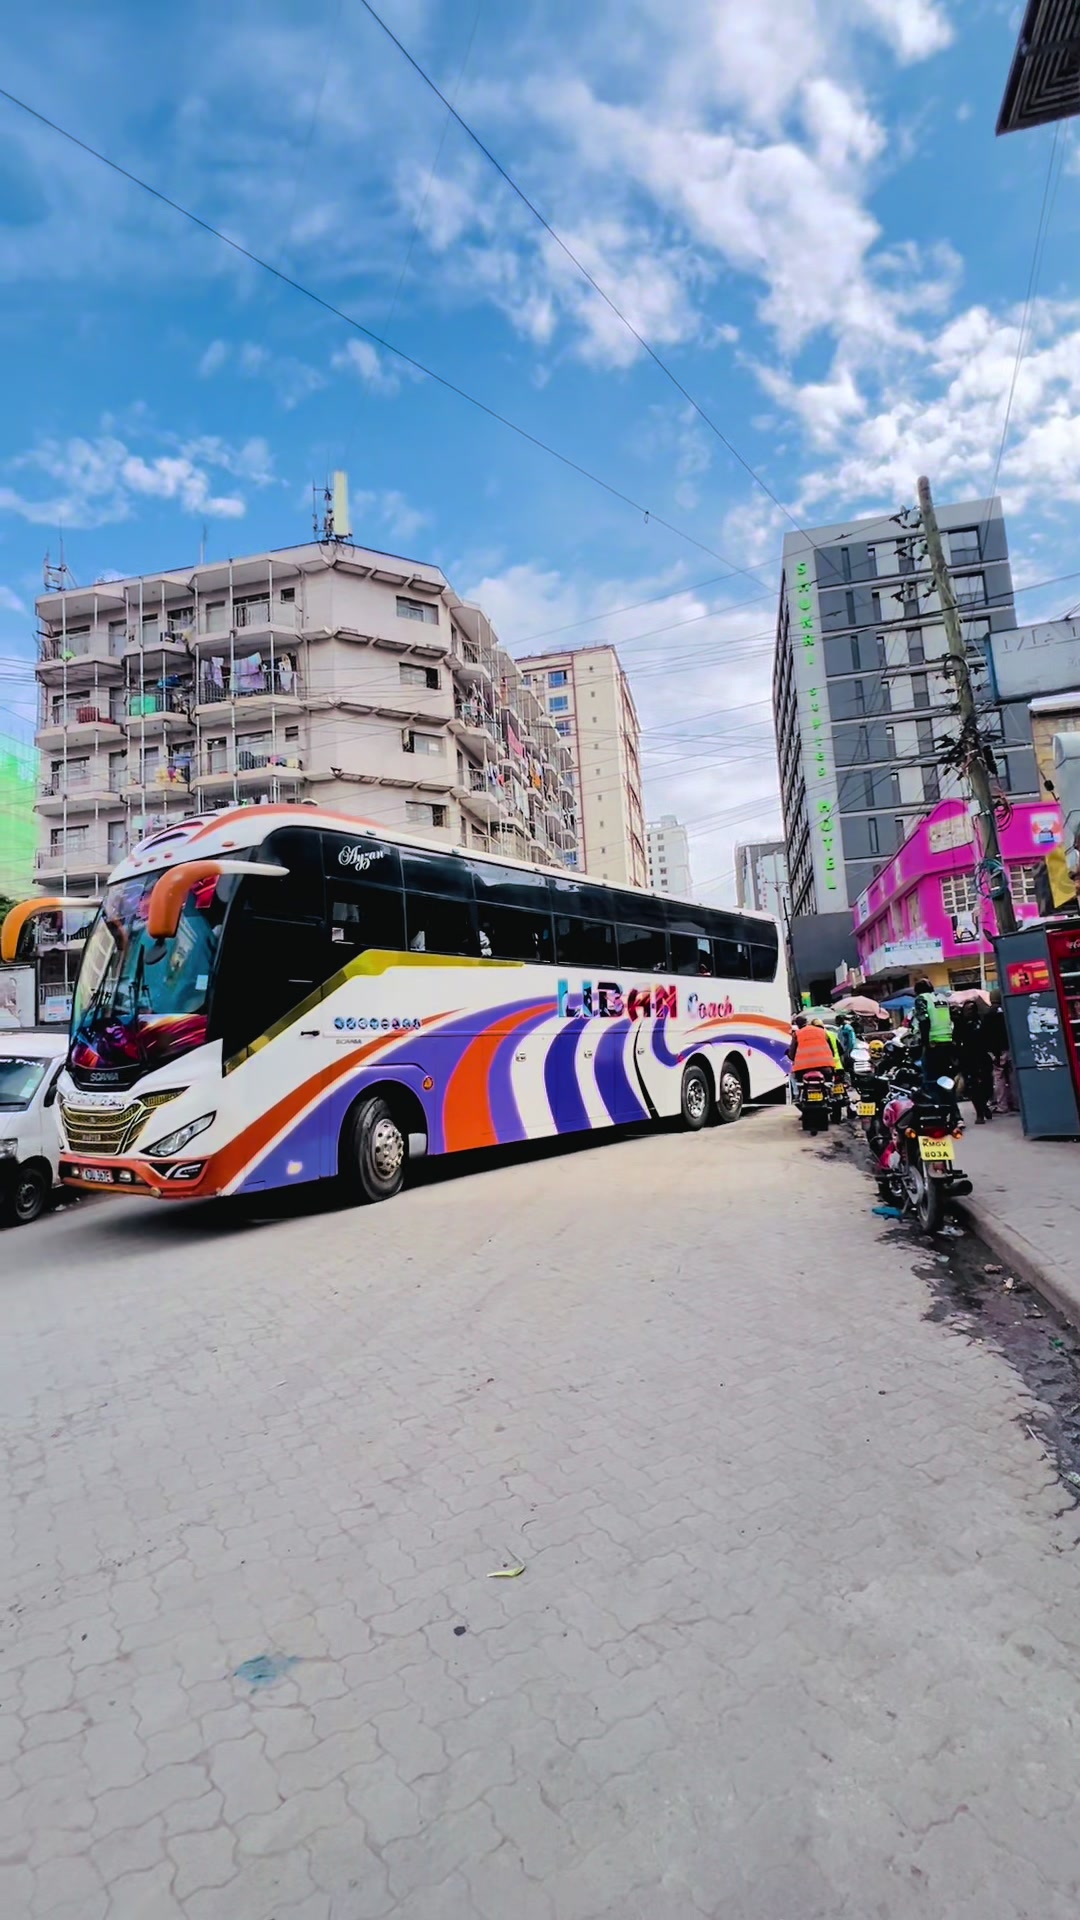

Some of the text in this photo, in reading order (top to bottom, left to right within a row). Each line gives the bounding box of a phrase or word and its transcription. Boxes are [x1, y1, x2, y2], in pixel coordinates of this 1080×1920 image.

[338, 845, 385, 872] Ayzan
[819, 801, 837, 890] HOTEL
[556, 978, 735, 1023] LIBAN Coach
[90, 1072, 119, 1082] SCANIA
